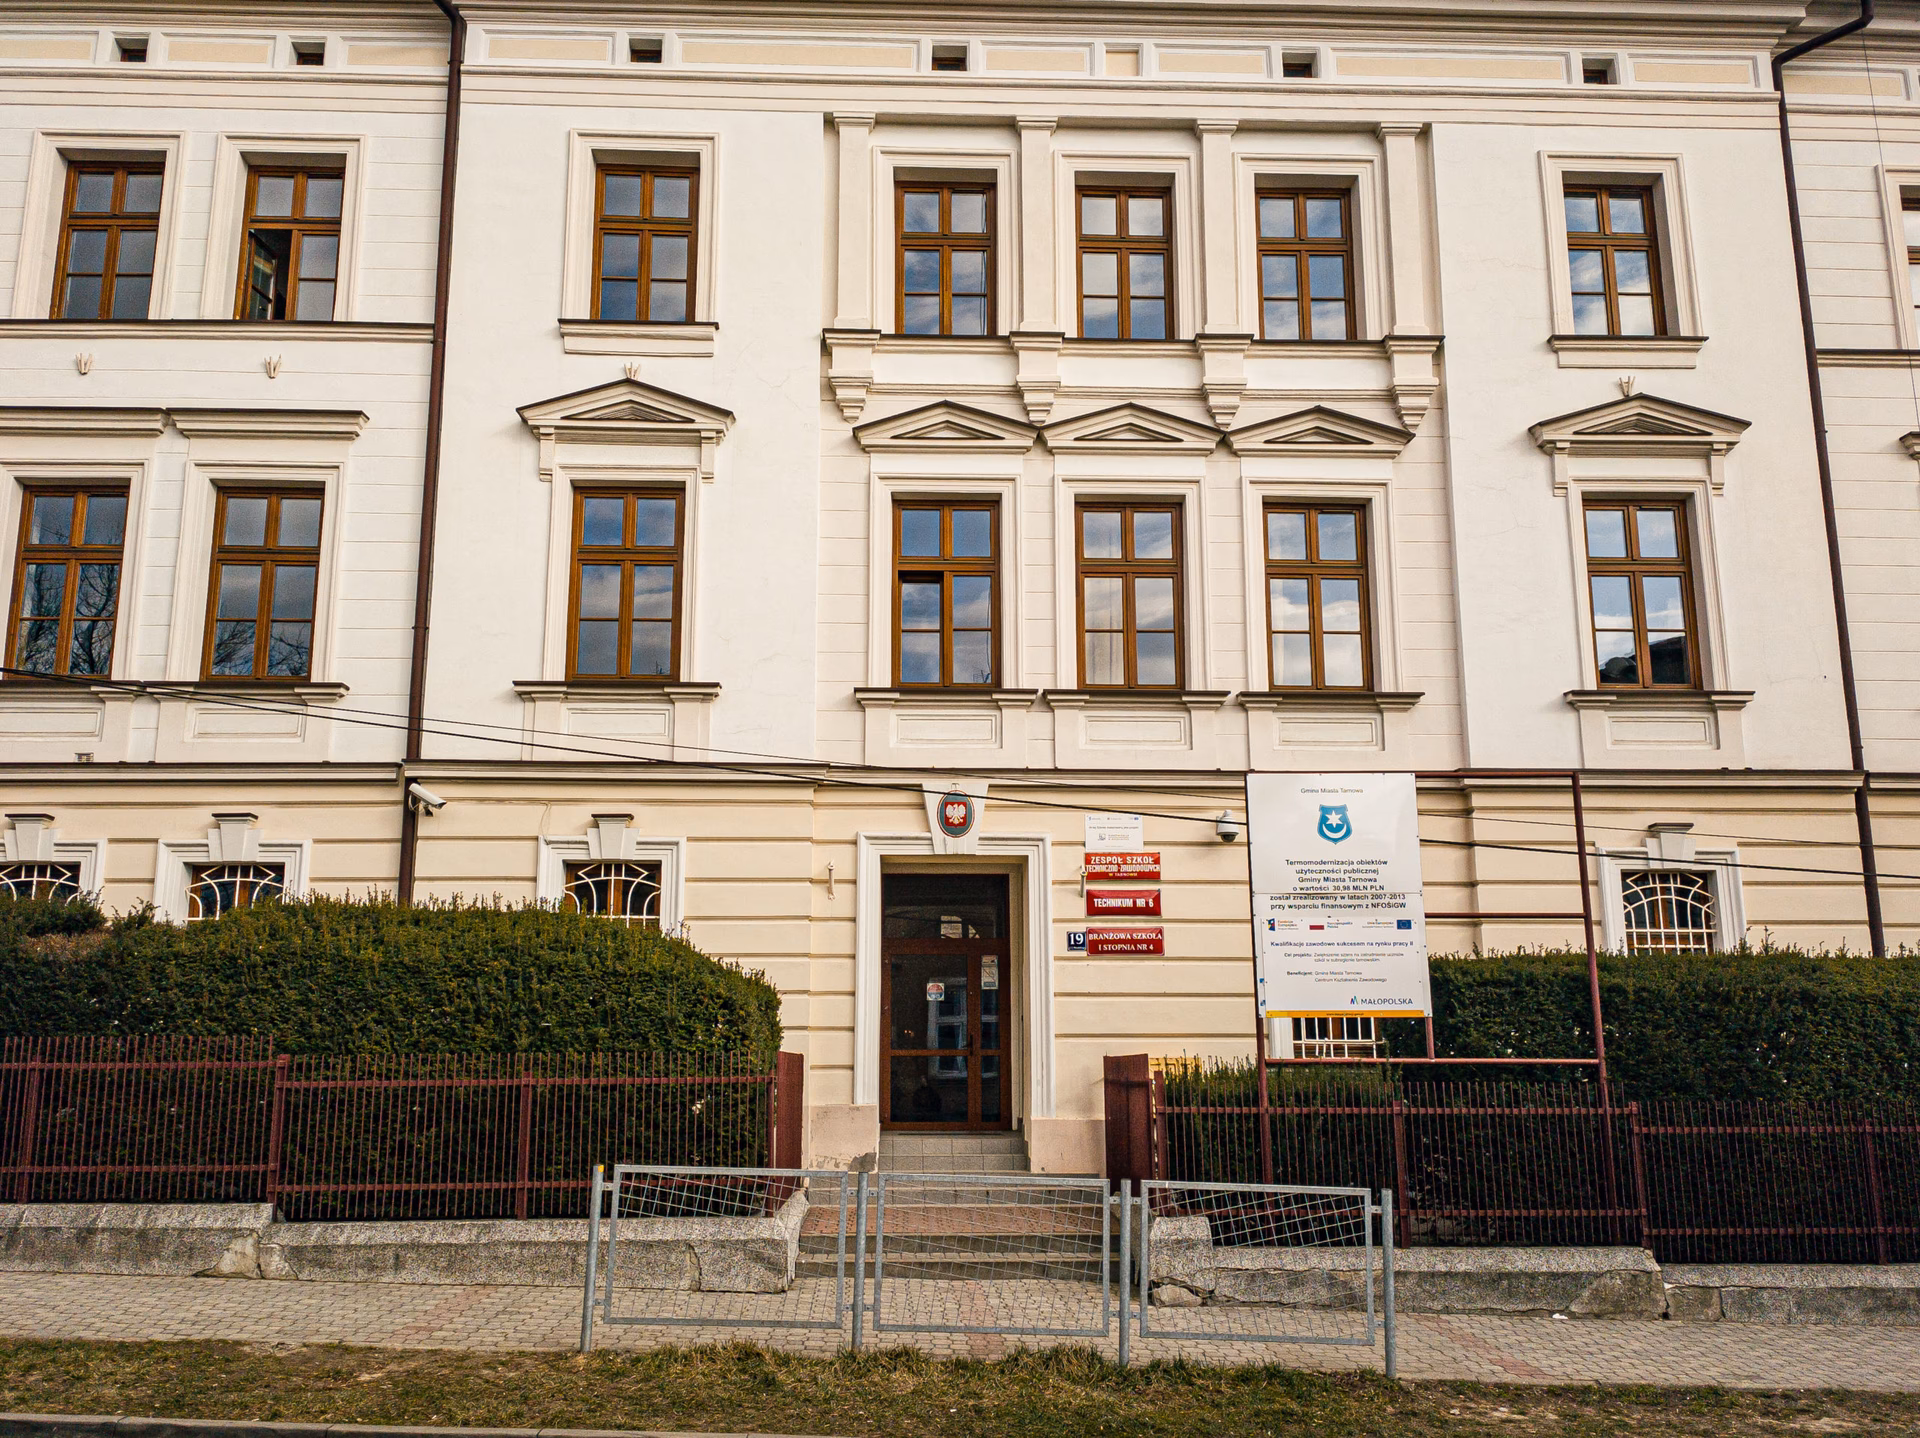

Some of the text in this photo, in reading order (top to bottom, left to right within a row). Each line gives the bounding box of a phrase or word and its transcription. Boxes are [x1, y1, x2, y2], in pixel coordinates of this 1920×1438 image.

[1094, 898, 1154, 908] TECHNIKUM NR 6
[1070, 933, 1084, 945] 19
[1088, 932, 1132, 940] BRANŻOWA
